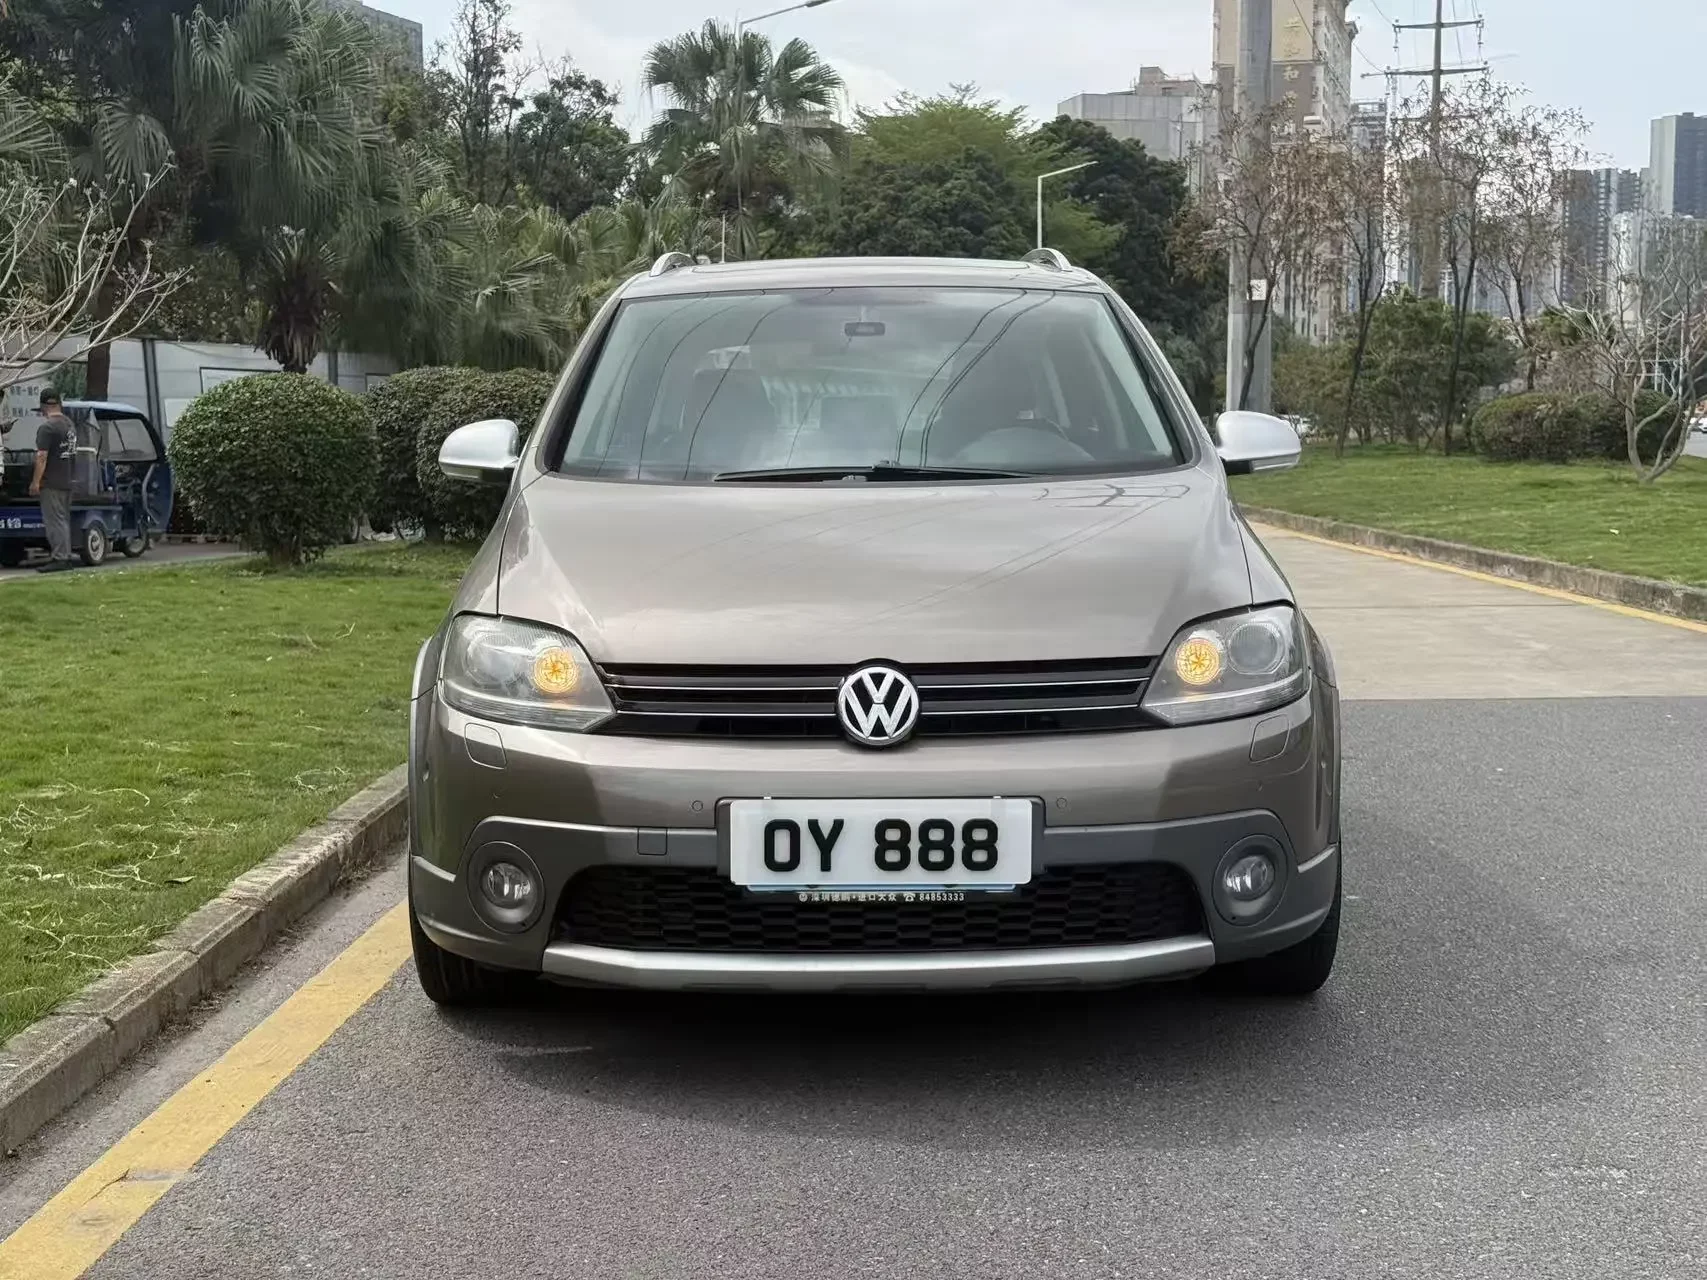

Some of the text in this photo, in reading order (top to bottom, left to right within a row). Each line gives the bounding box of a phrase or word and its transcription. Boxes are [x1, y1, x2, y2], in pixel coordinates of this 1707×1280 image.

[764, 818, 998, 872] OY 888
[919, 892, 965, 902] 84853333
